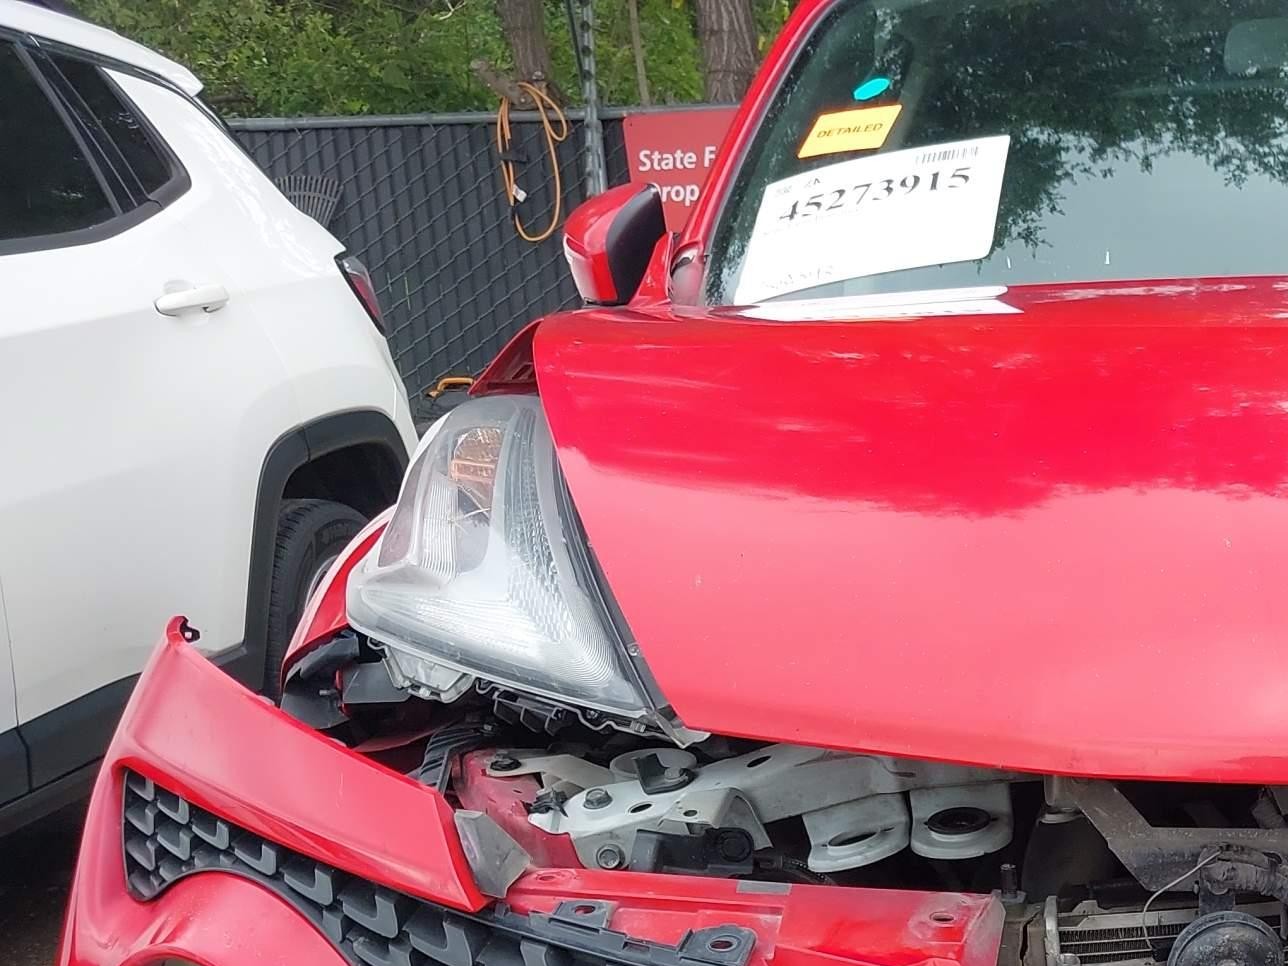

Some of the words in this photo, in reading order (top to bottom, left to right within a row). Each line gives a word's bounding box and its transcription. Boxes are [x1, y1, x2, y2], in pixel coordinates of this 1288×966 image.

[816, 122, 884, 139] DETAILED
[638, 149, 697, 172] State
[778, 166, 972, 222] 45273915
